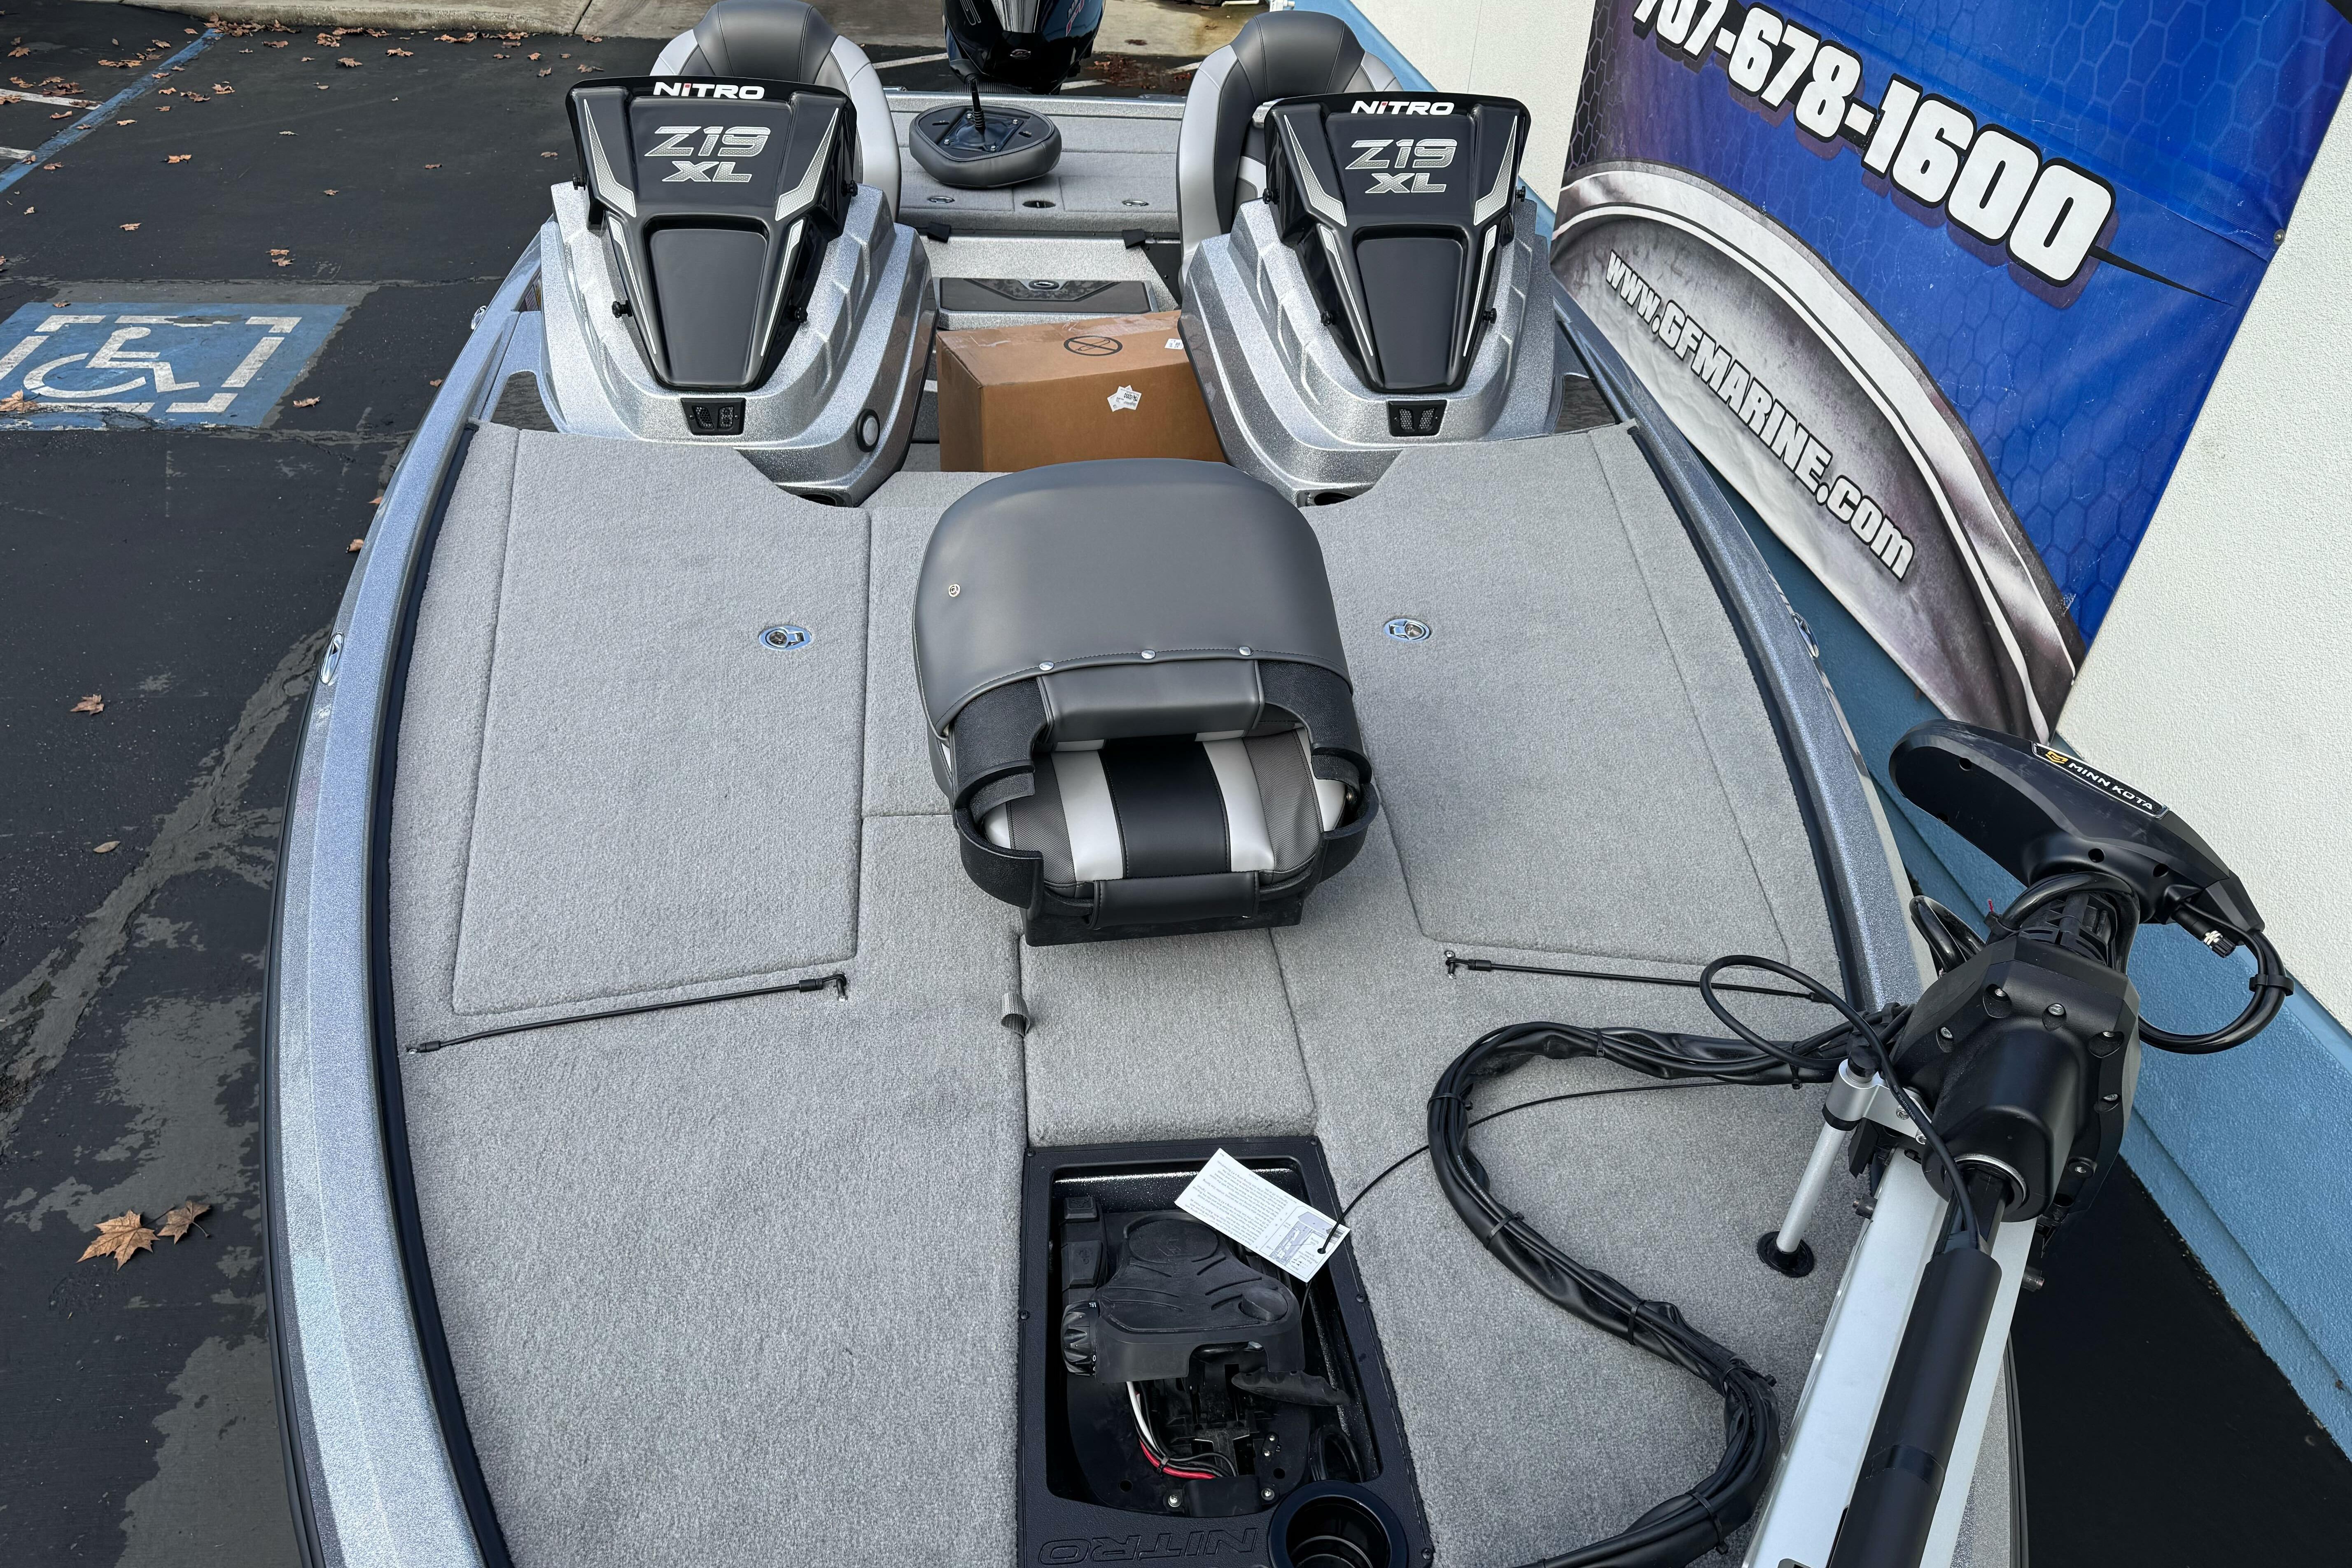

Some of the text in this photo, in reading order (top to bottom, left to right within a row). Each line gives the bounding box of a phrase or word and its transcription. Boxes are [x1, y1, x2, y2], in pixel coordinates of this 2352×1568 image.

[644, 126, 771, 157] Z19
[1345, 138, 1458, 170] Z19
[662, 161, 753, 183] XL
[1365, 172, 1447, 194] XL
[2068, 763, 2153, 810] MINN KOTA
[1038, 1528, 1259, 1565] NITRO
